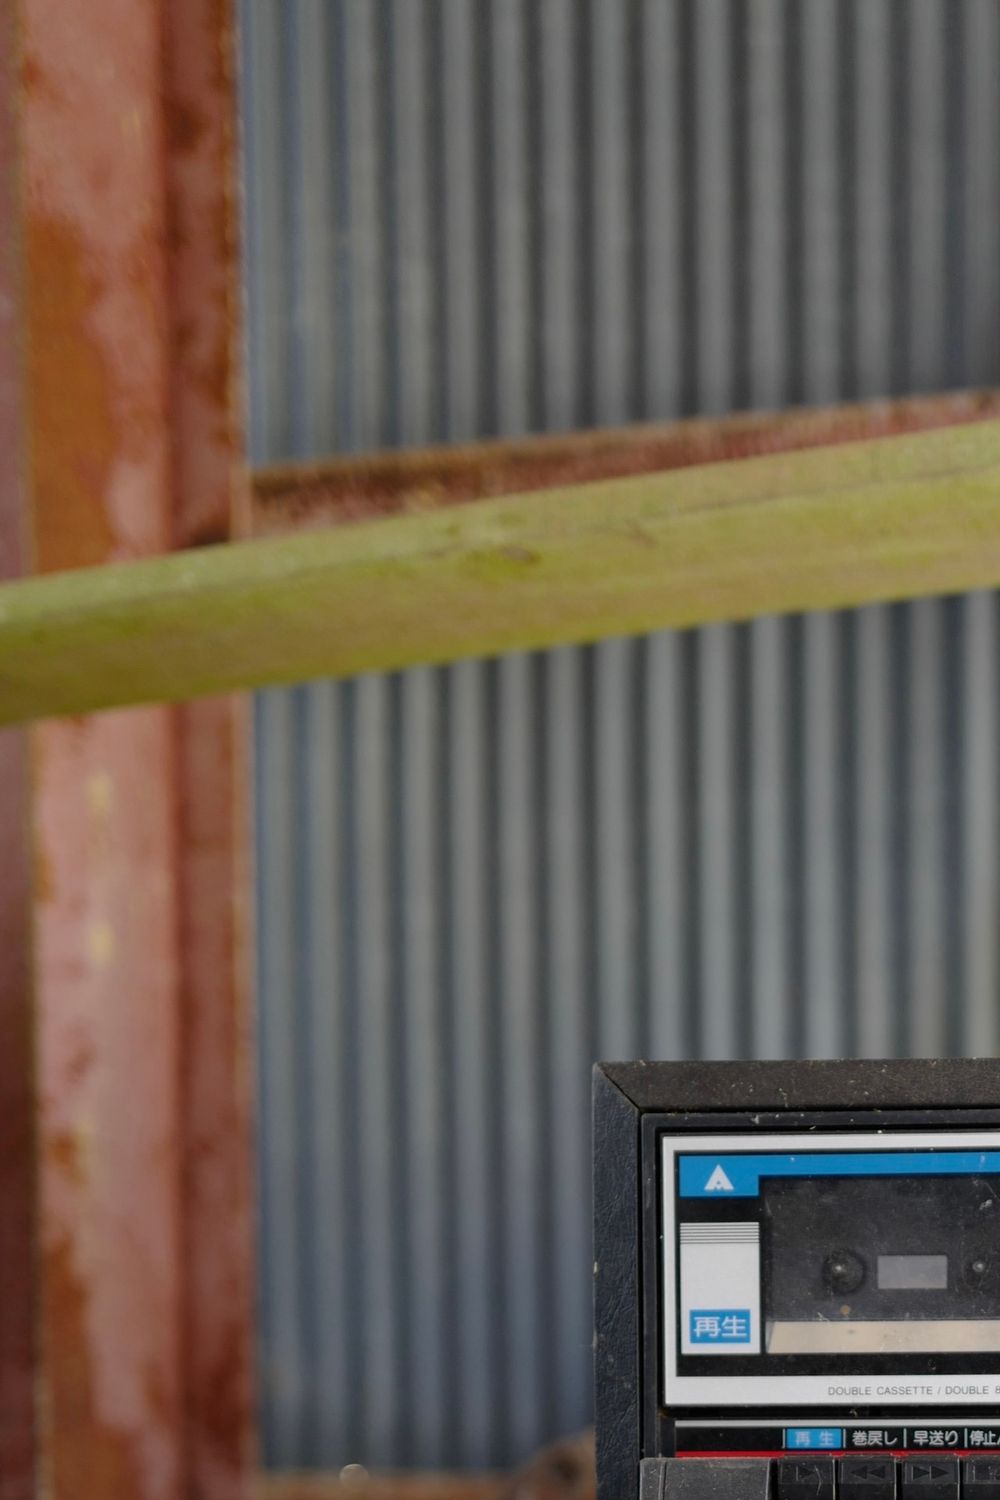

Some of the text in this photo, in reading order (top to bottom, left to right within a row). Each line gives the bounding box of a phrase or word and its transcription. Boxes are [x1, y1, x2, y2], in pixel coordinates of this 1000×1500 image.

[704, 1164, 734, 1190] A
[693, 1316, 748, 1338] 再生
[828, 1386, 872, 1396] DOUBLE
[876, 1386, 933, 1396] CASSETTE
[945, 1385, 988, 1395] DOUBLE
[794, 1431, 835, 1446] 再生
[852, 1430, 898, 1446] 巻戻し
[913, 1430, 958, 1446] 早送り
